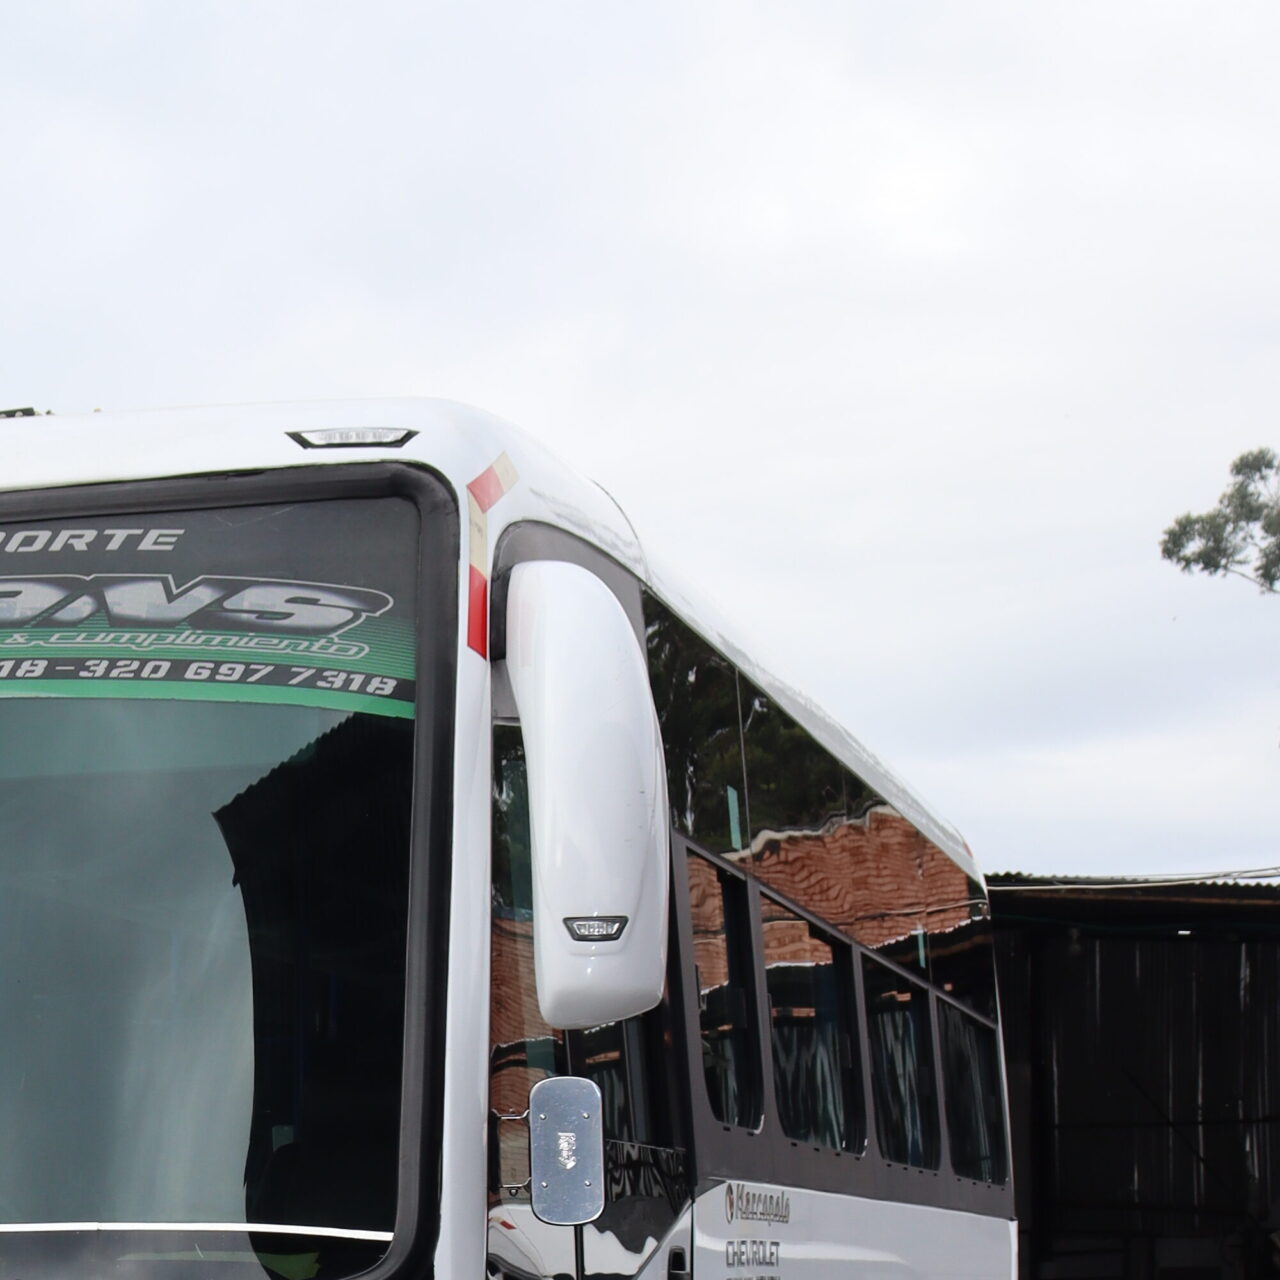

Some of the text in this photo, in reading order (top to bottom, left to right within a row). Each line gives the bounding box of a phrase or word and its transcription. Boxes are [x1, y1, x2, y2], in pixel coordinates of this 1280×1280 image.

[48, 630, 366, 657] cumplimiento
[184, 661, 276, 682] 697
[286, 667, 398, 697] 7318
[726, 1240, 780, 1268] CHEVROLET
